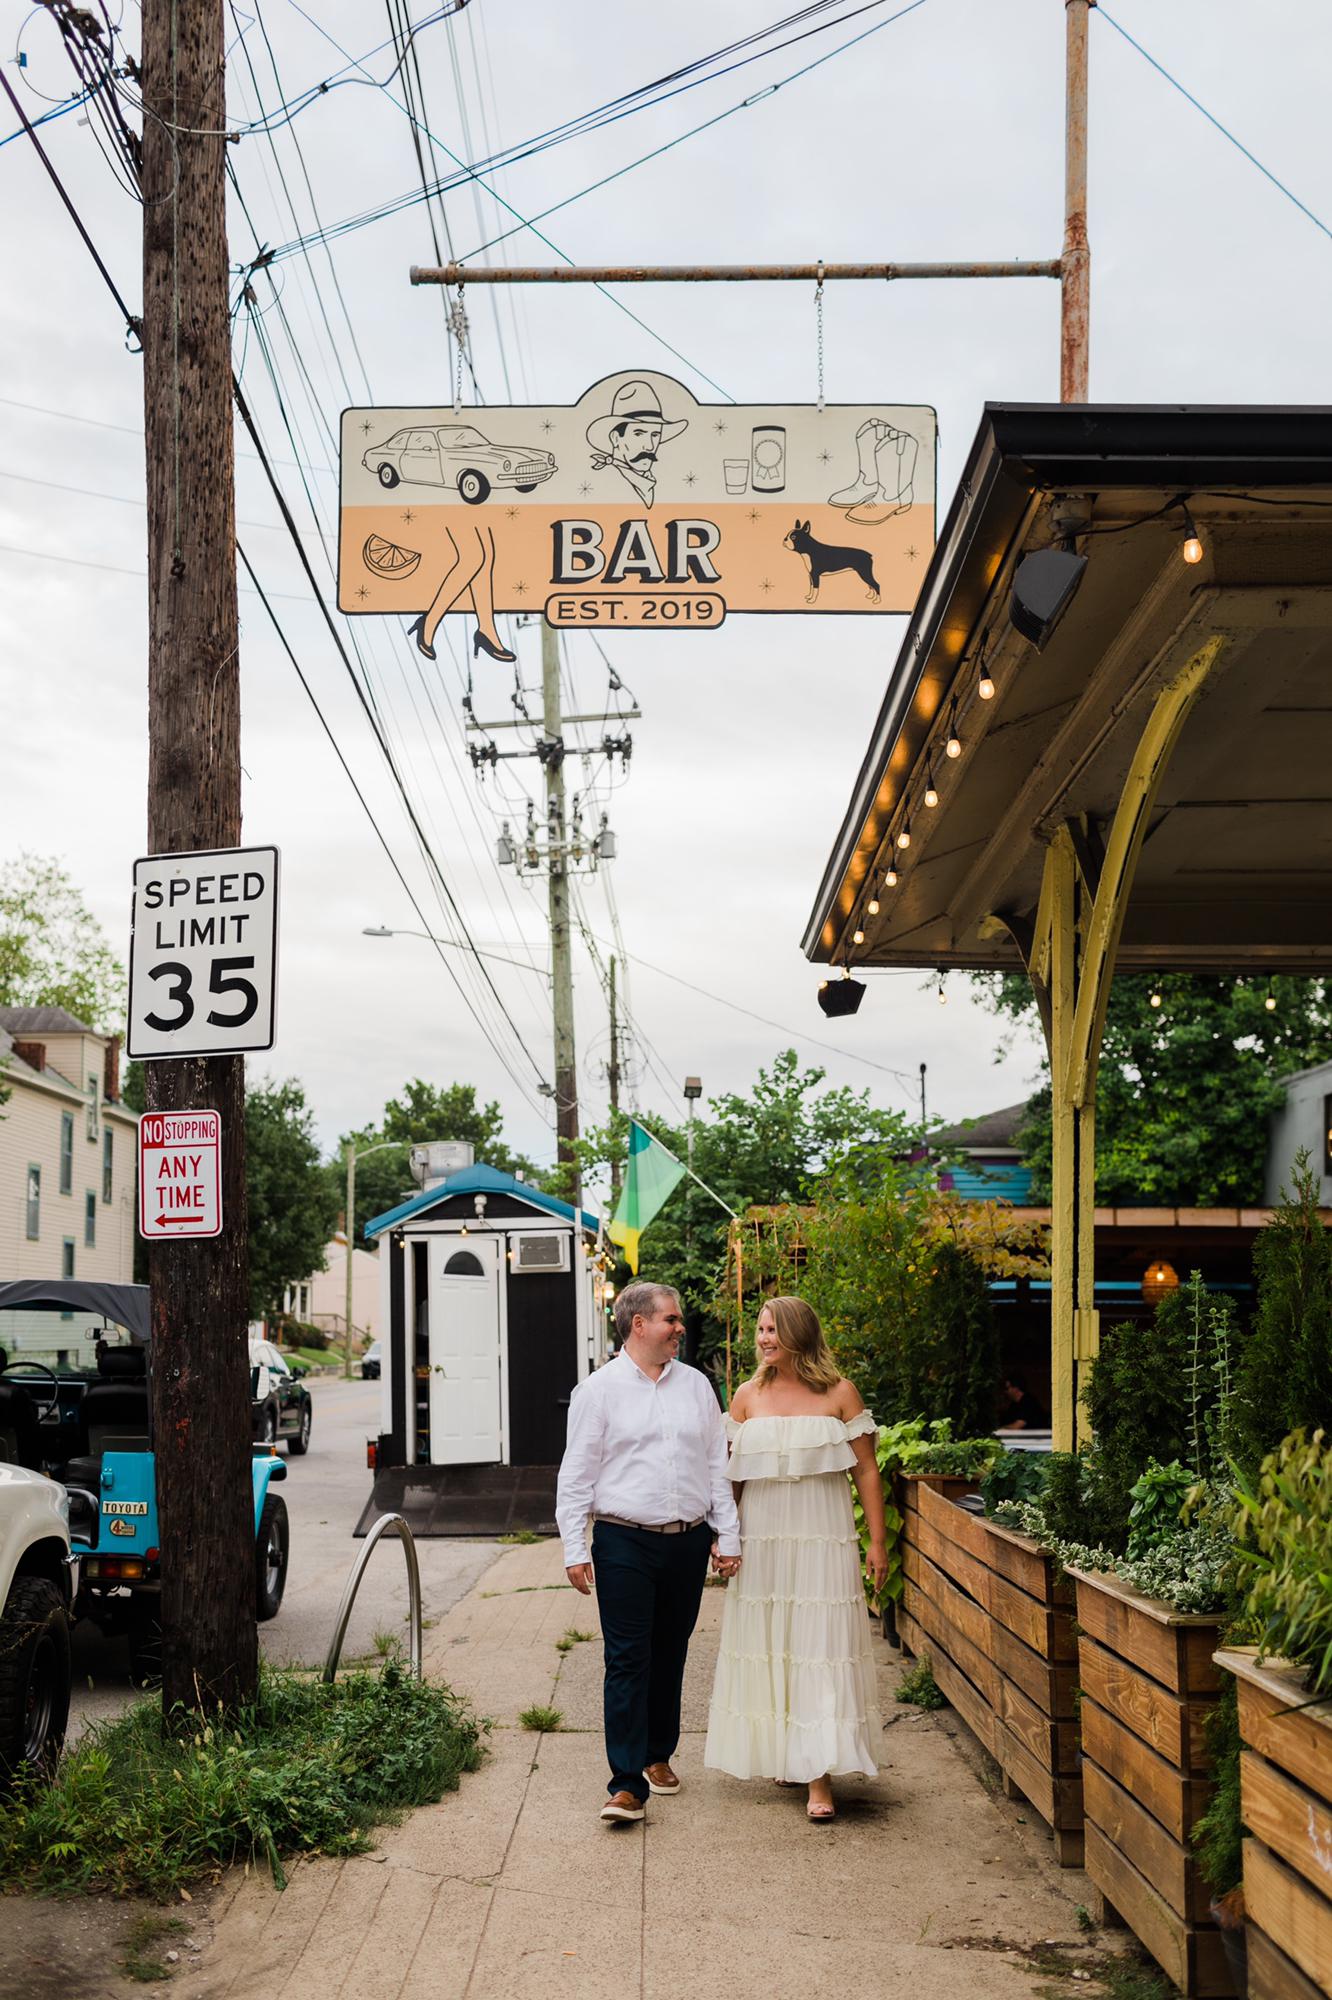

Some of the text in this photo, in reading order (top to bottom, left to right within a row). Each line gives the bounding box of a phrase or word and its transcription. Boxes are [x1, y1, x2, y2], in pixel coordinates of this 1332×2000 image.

[549, 519, 722, 584] BAR
[557, 600, 714, 620] EST. 2019
[144, 871, 265, 909] SPEED
[155, 914, 249, 949] LIMIT
[143, 956, 259, 1032] 35
[143, 1120, 216, 1143] NO STOPPING
[158, 1155, 202, 1179] ANY
[156, 1185, 205, 1208] TIME
[105, 1503, 144, 1513] TOYOTA
